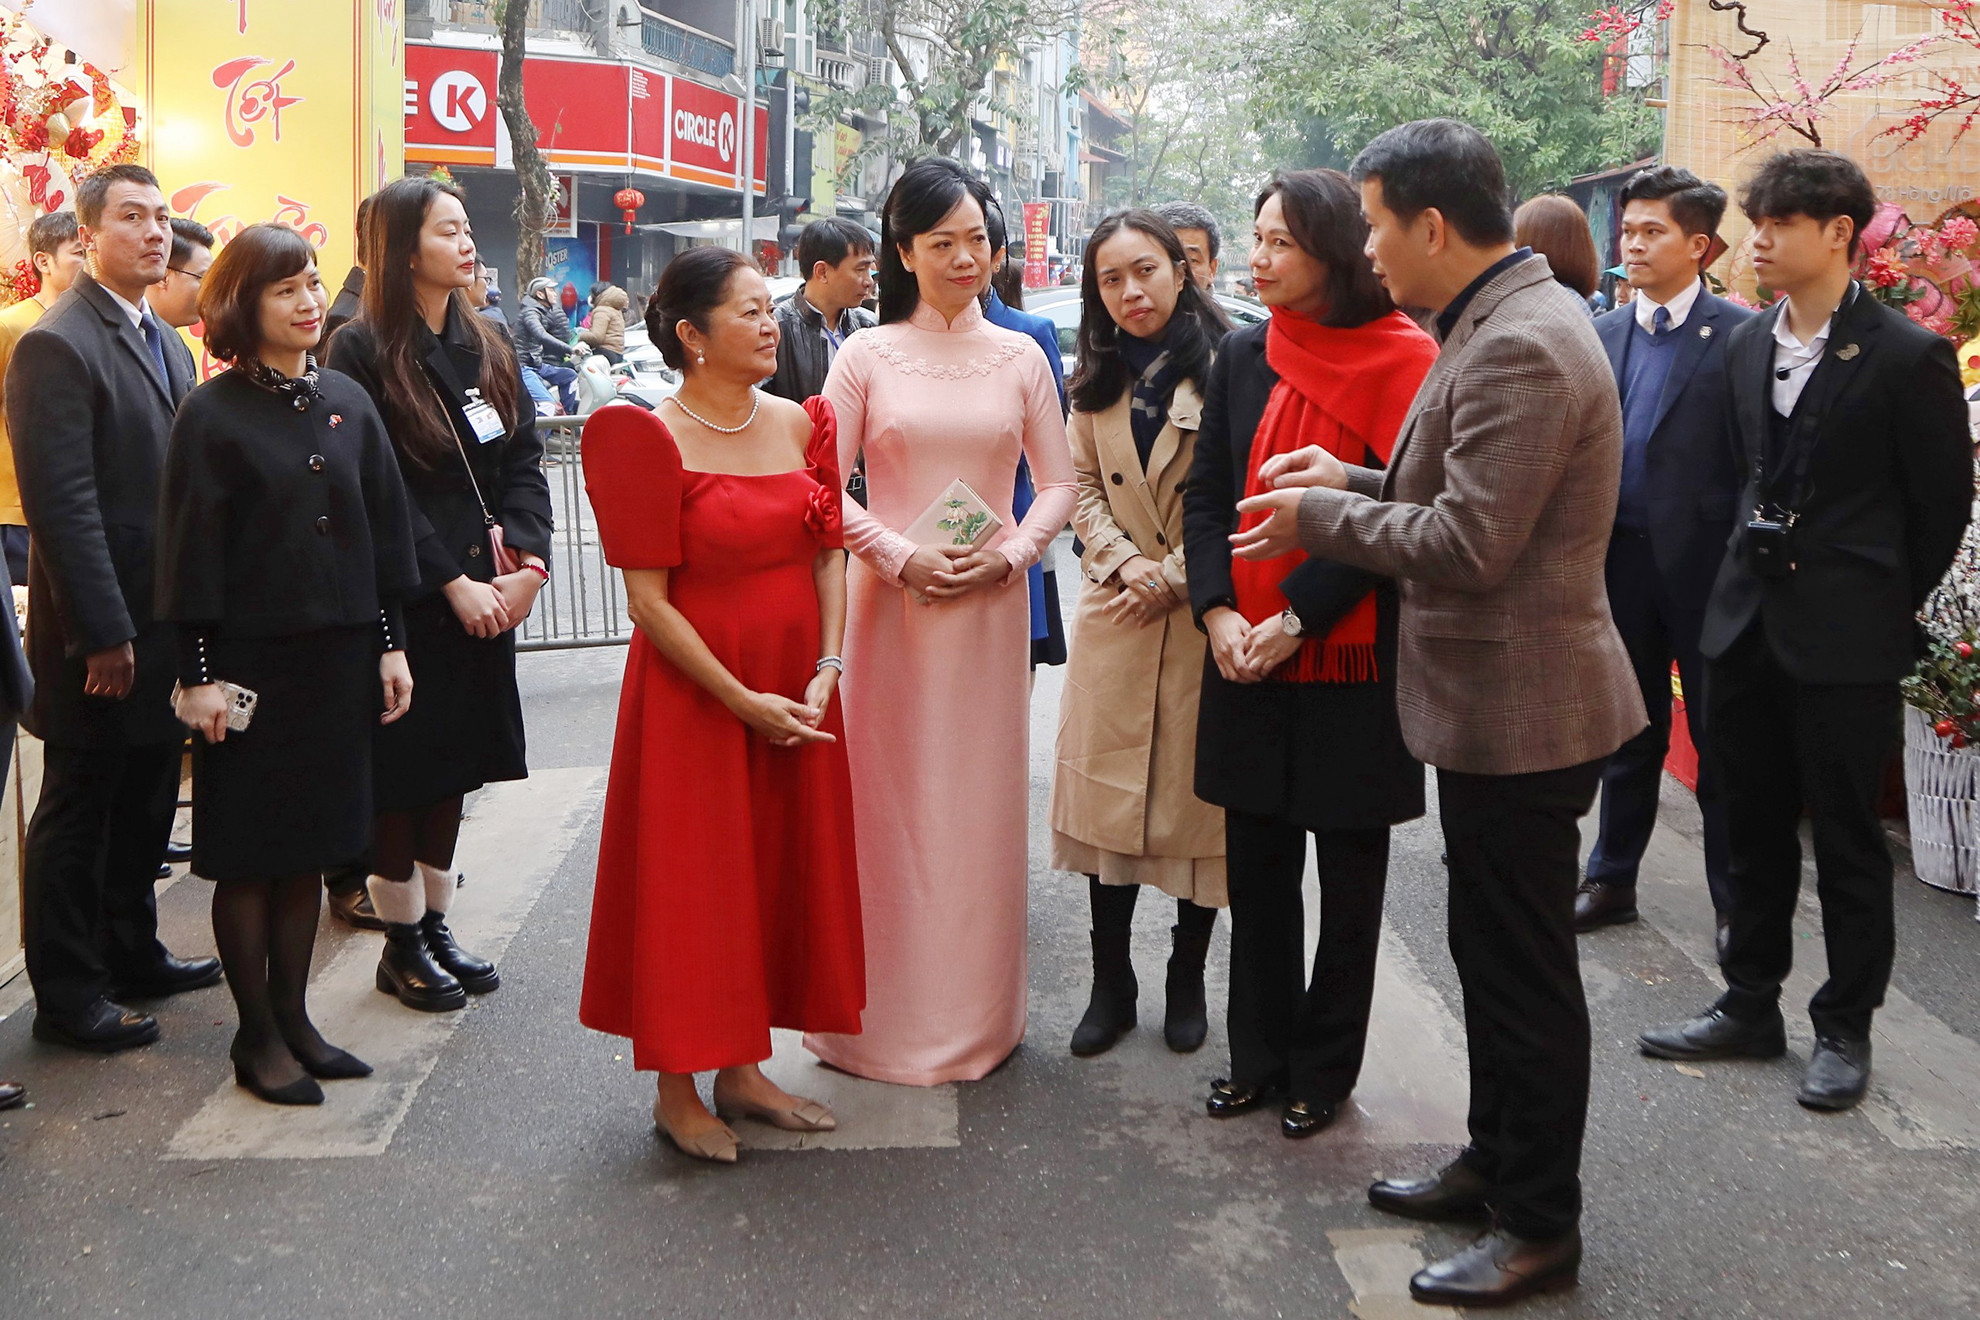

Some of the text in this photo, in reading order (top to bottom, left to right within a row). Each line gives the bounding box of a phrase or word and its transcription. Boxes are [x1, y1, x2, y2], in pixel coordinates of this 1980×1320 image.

[212, 57, 304, 147] Tết
[441, 79, 482, 130] K
[674, 108, 735, 161] CIRCLE K
